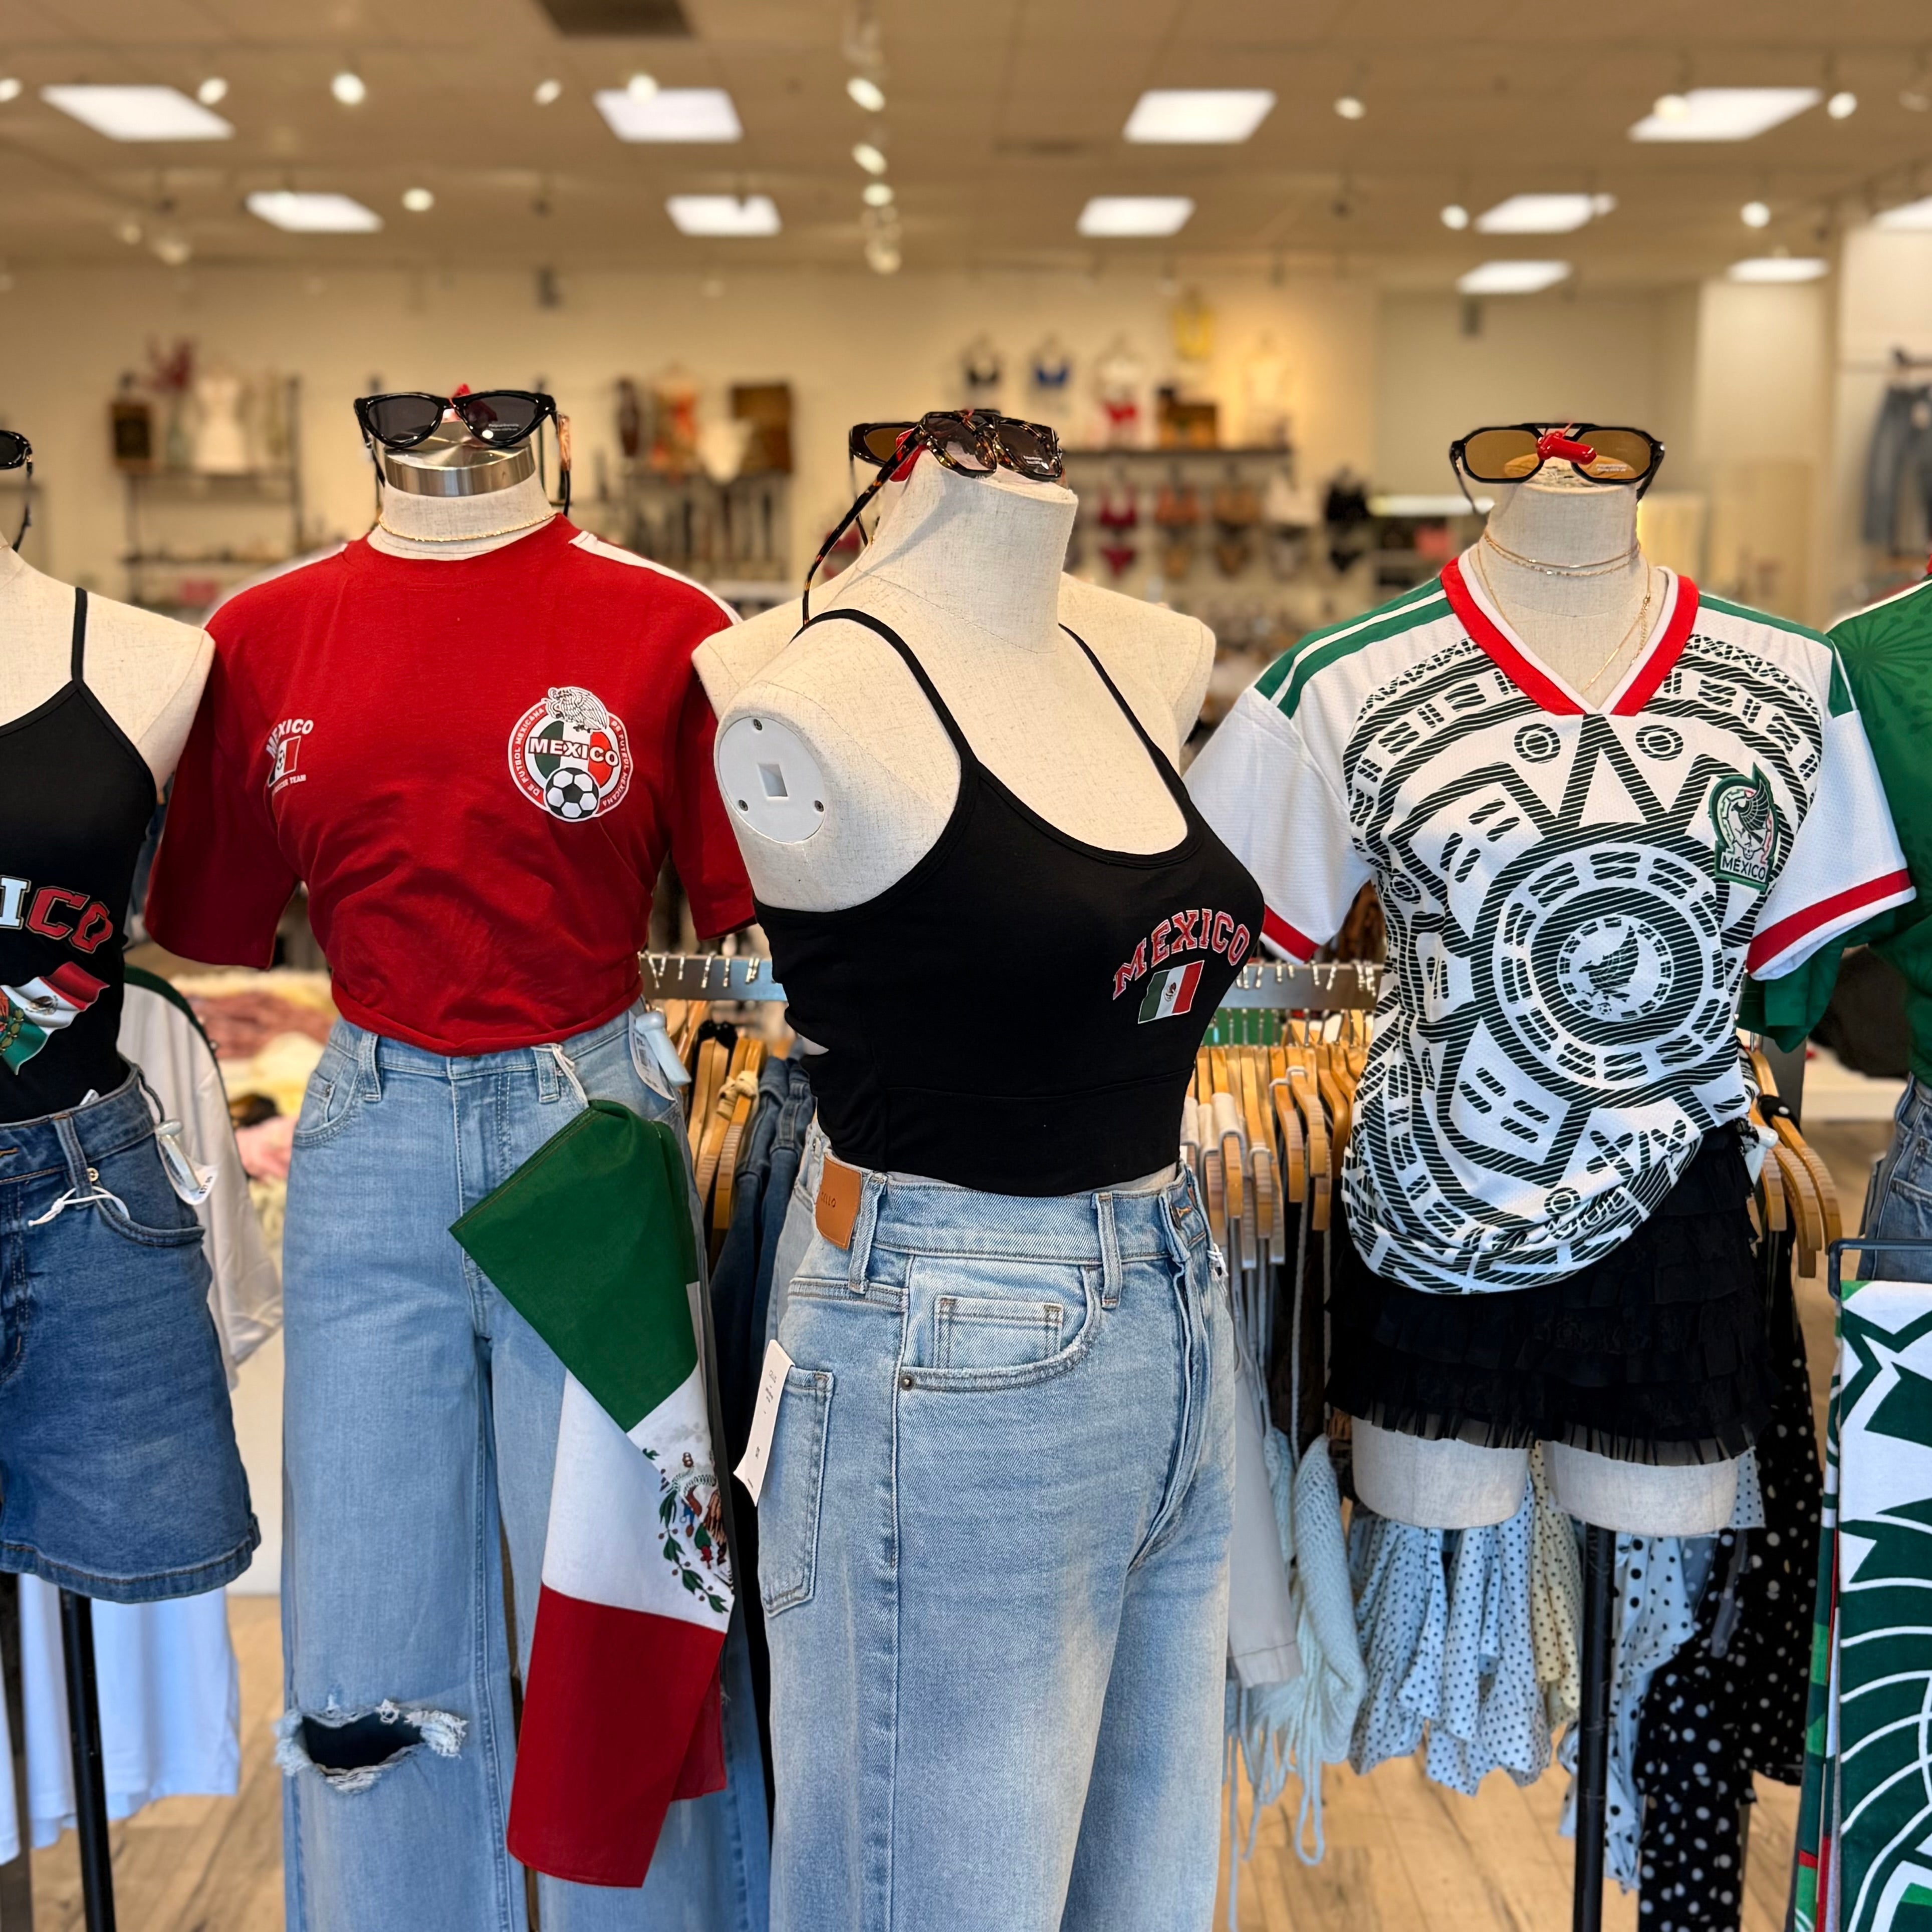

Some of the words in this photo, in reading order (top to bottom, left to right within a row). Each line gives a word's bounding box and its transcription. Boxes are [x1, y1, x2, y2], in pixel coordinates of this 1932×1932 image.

[529, 737, 620, 767] MEXICO
[1723, 856, 1766, 880] MÉXICO
[1112, 908, 1250, 1001] MEXICO
